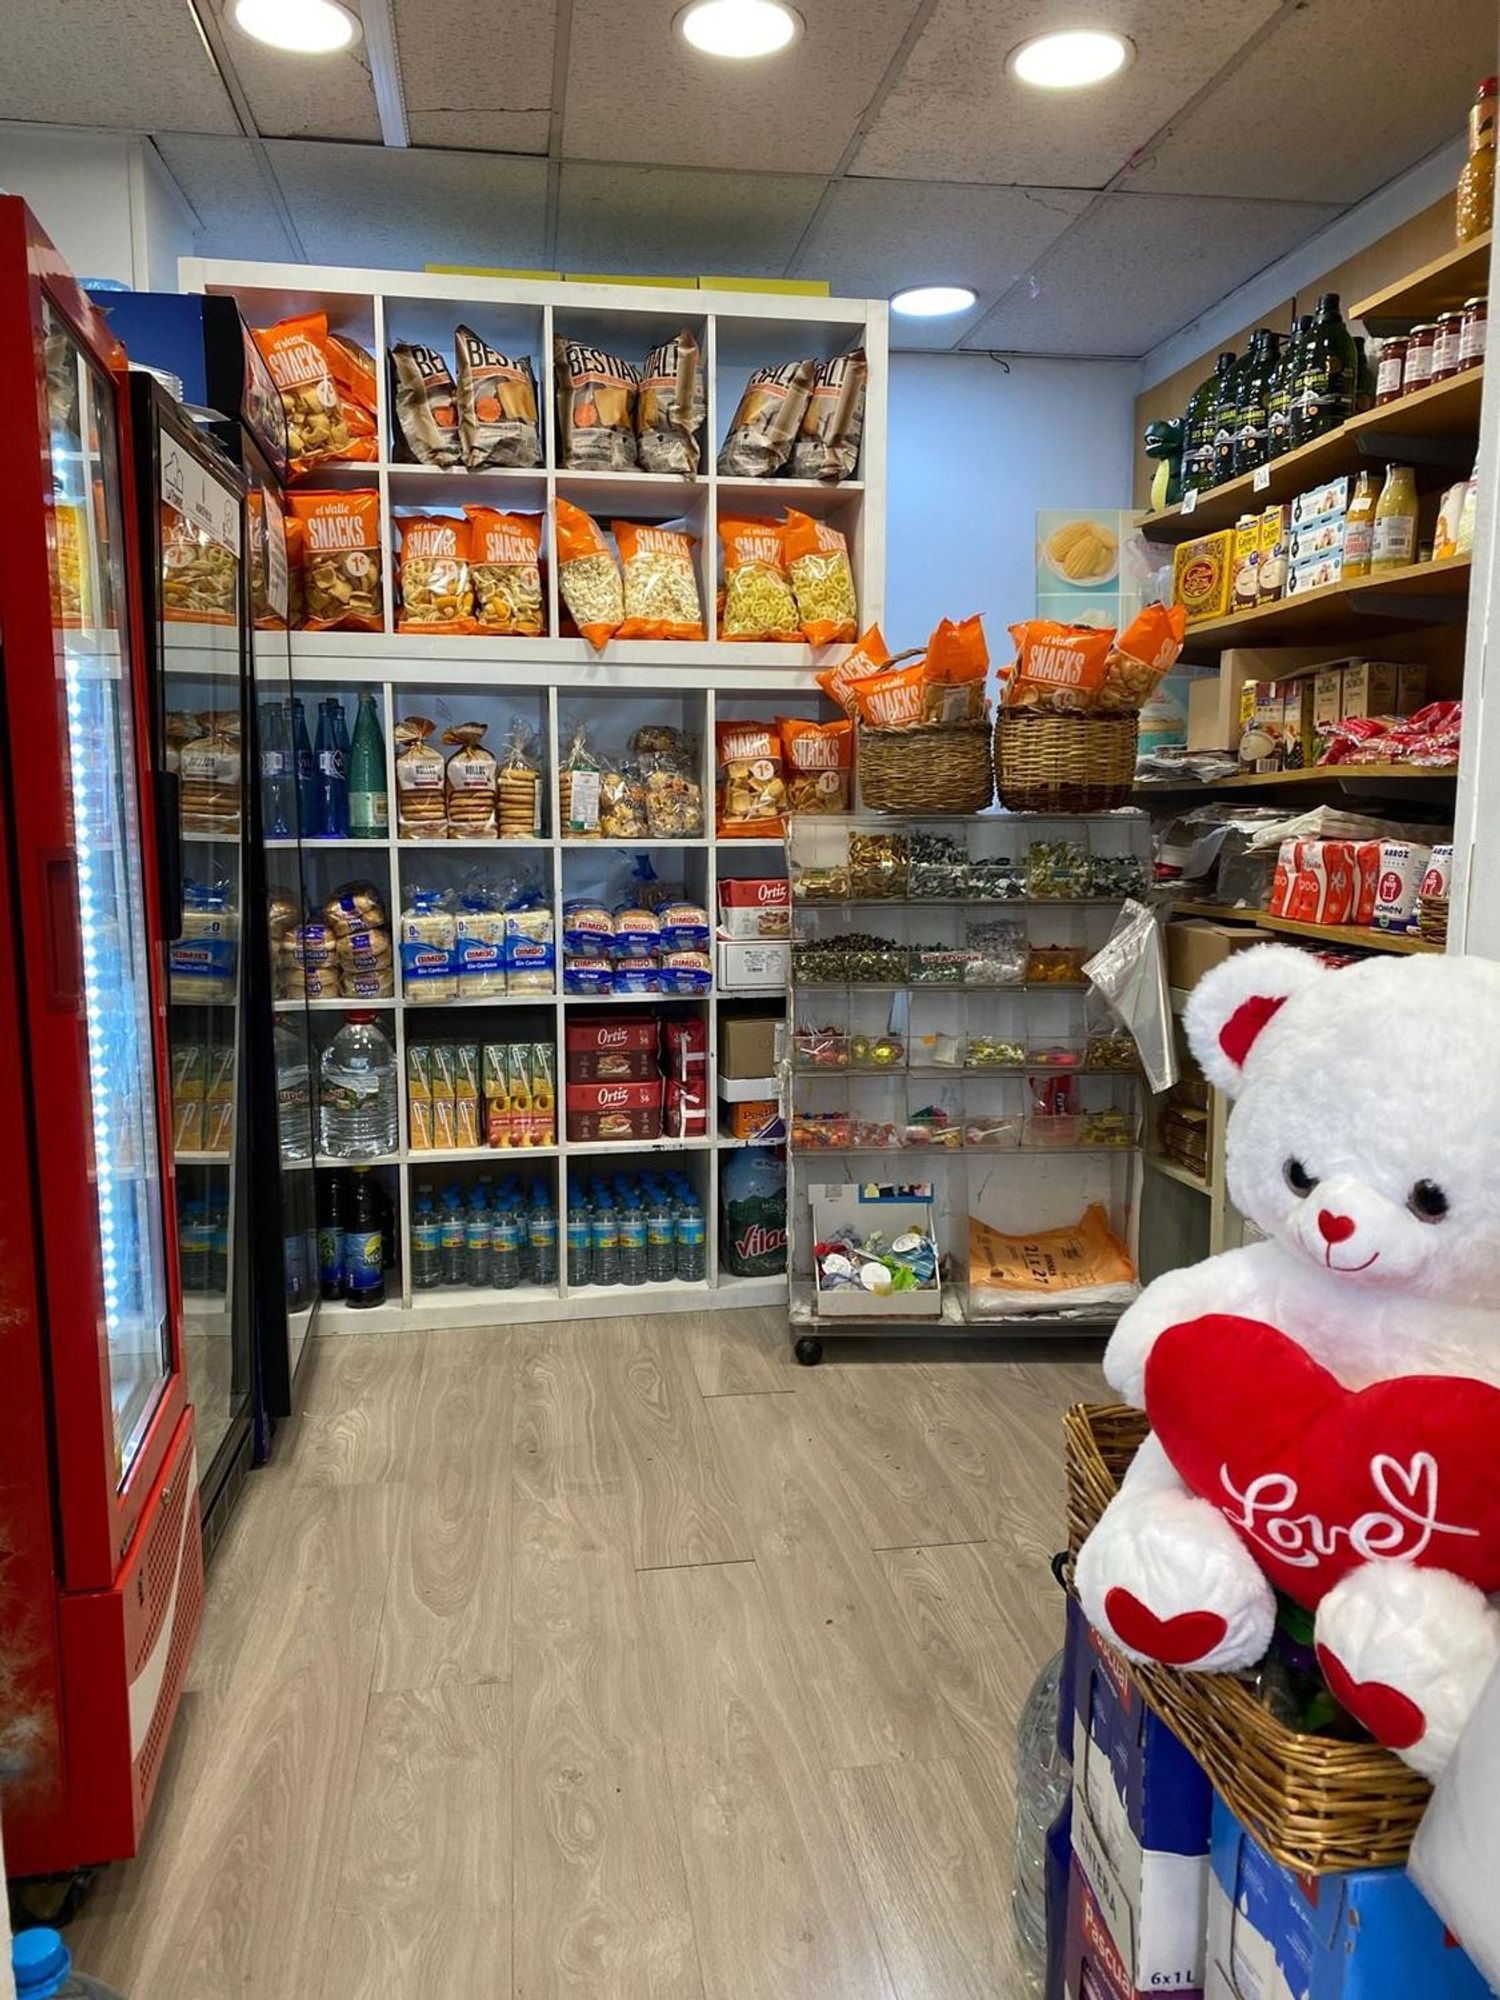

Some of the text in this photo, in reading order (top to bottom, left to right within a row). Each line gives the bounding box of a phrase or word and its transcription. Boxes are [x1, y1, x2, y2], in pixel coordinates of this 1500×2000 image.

[268, 345, 328, 387] SNACKS
[308, 516, 365, 549] SNACKS
[636, 529, 690, 557] SNACKS
[486, 532, 537, 563] SNACKS
[1028, 645, 1085, 685] SNACKS
[866, 684, 921, 724] SNACKS
[792, 738, 839, 767] SNACKS
[758, 883, 787, 904] Ortiz
[417, 955, 447, 963] BIMBO
[467, 949, 496, 959] BIMBO
[516, 947, 544, 956] BIMBO
[598, 1026, 628, 1046] Ortiz
[598, 1086, 629, 1105] Ortiz
[1220, 1455, 1455, 1567] Love
